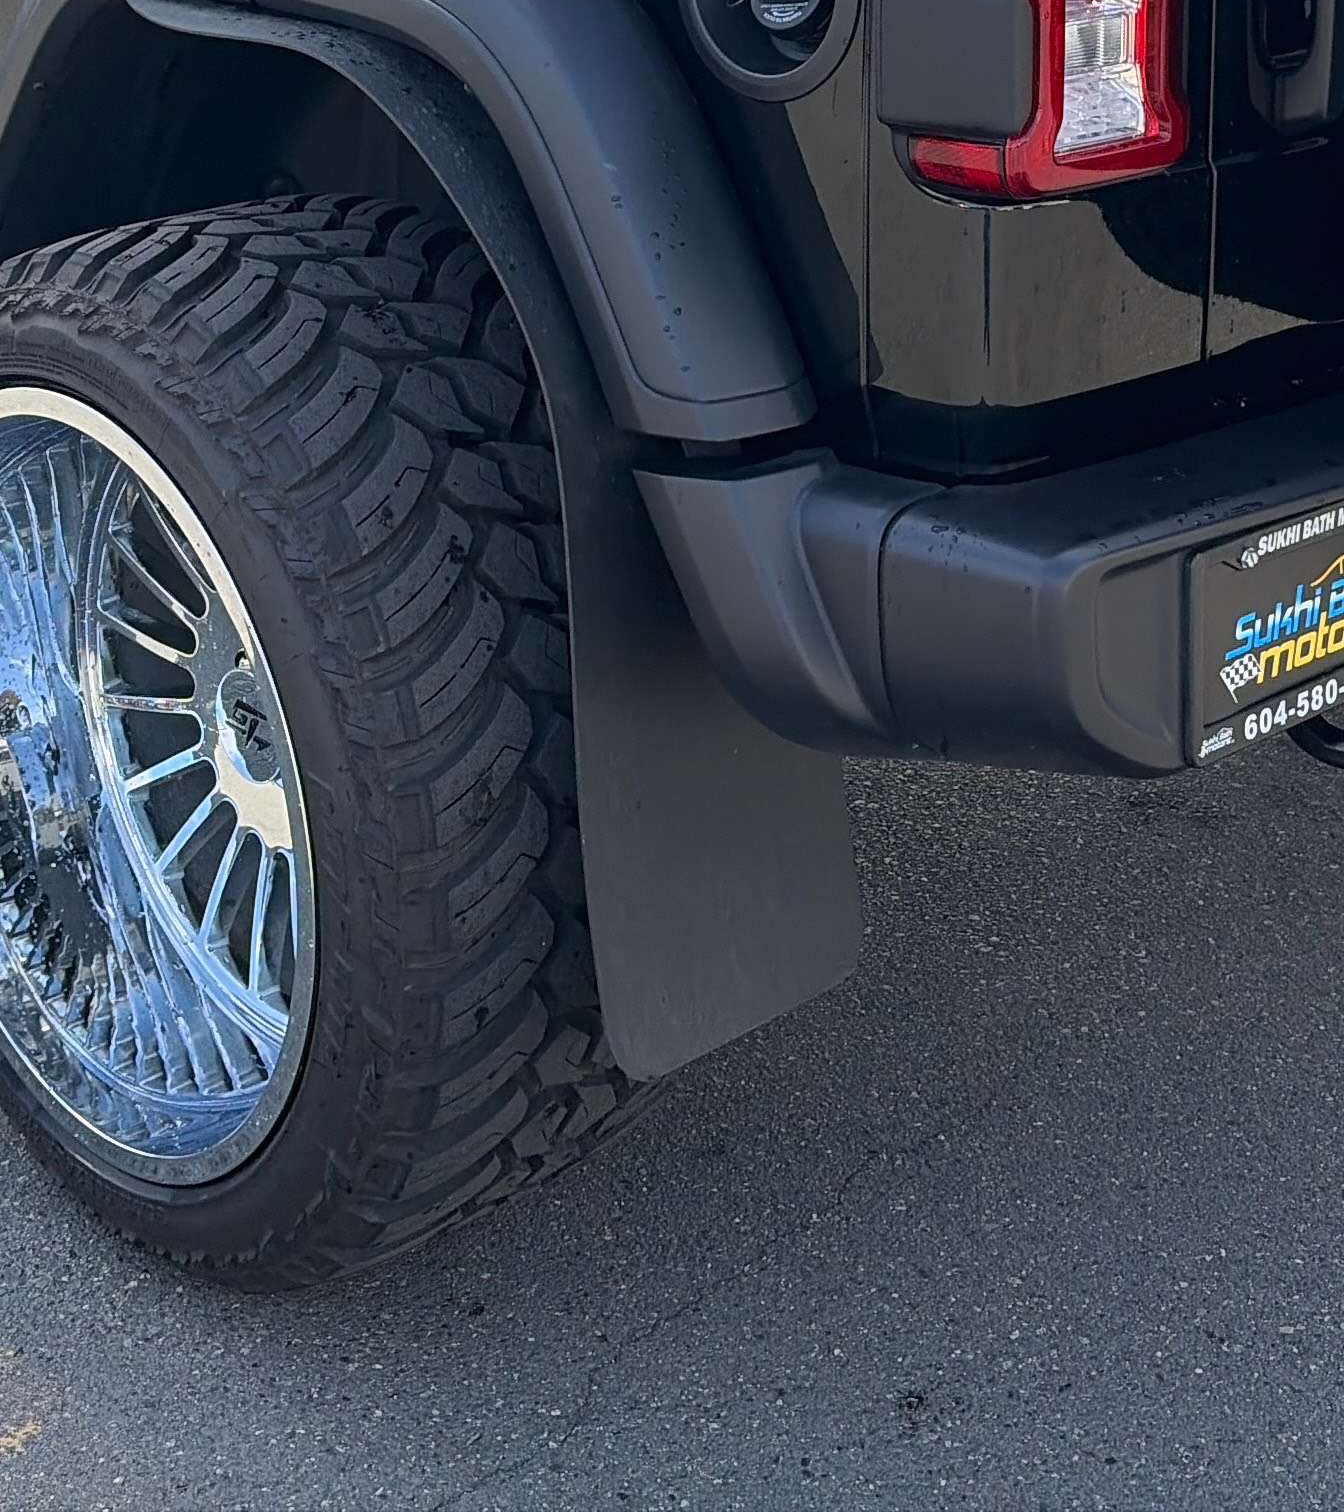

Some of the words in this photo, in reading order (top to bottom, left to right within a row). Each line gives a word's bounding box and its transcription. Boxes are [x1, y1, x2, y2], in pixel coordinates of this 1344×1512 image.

[1257, 524, 1301, 557] SUKHI
[1302, 512, 1336, 540] BATH
[1225, 585, 1323, 661] Sukhi
